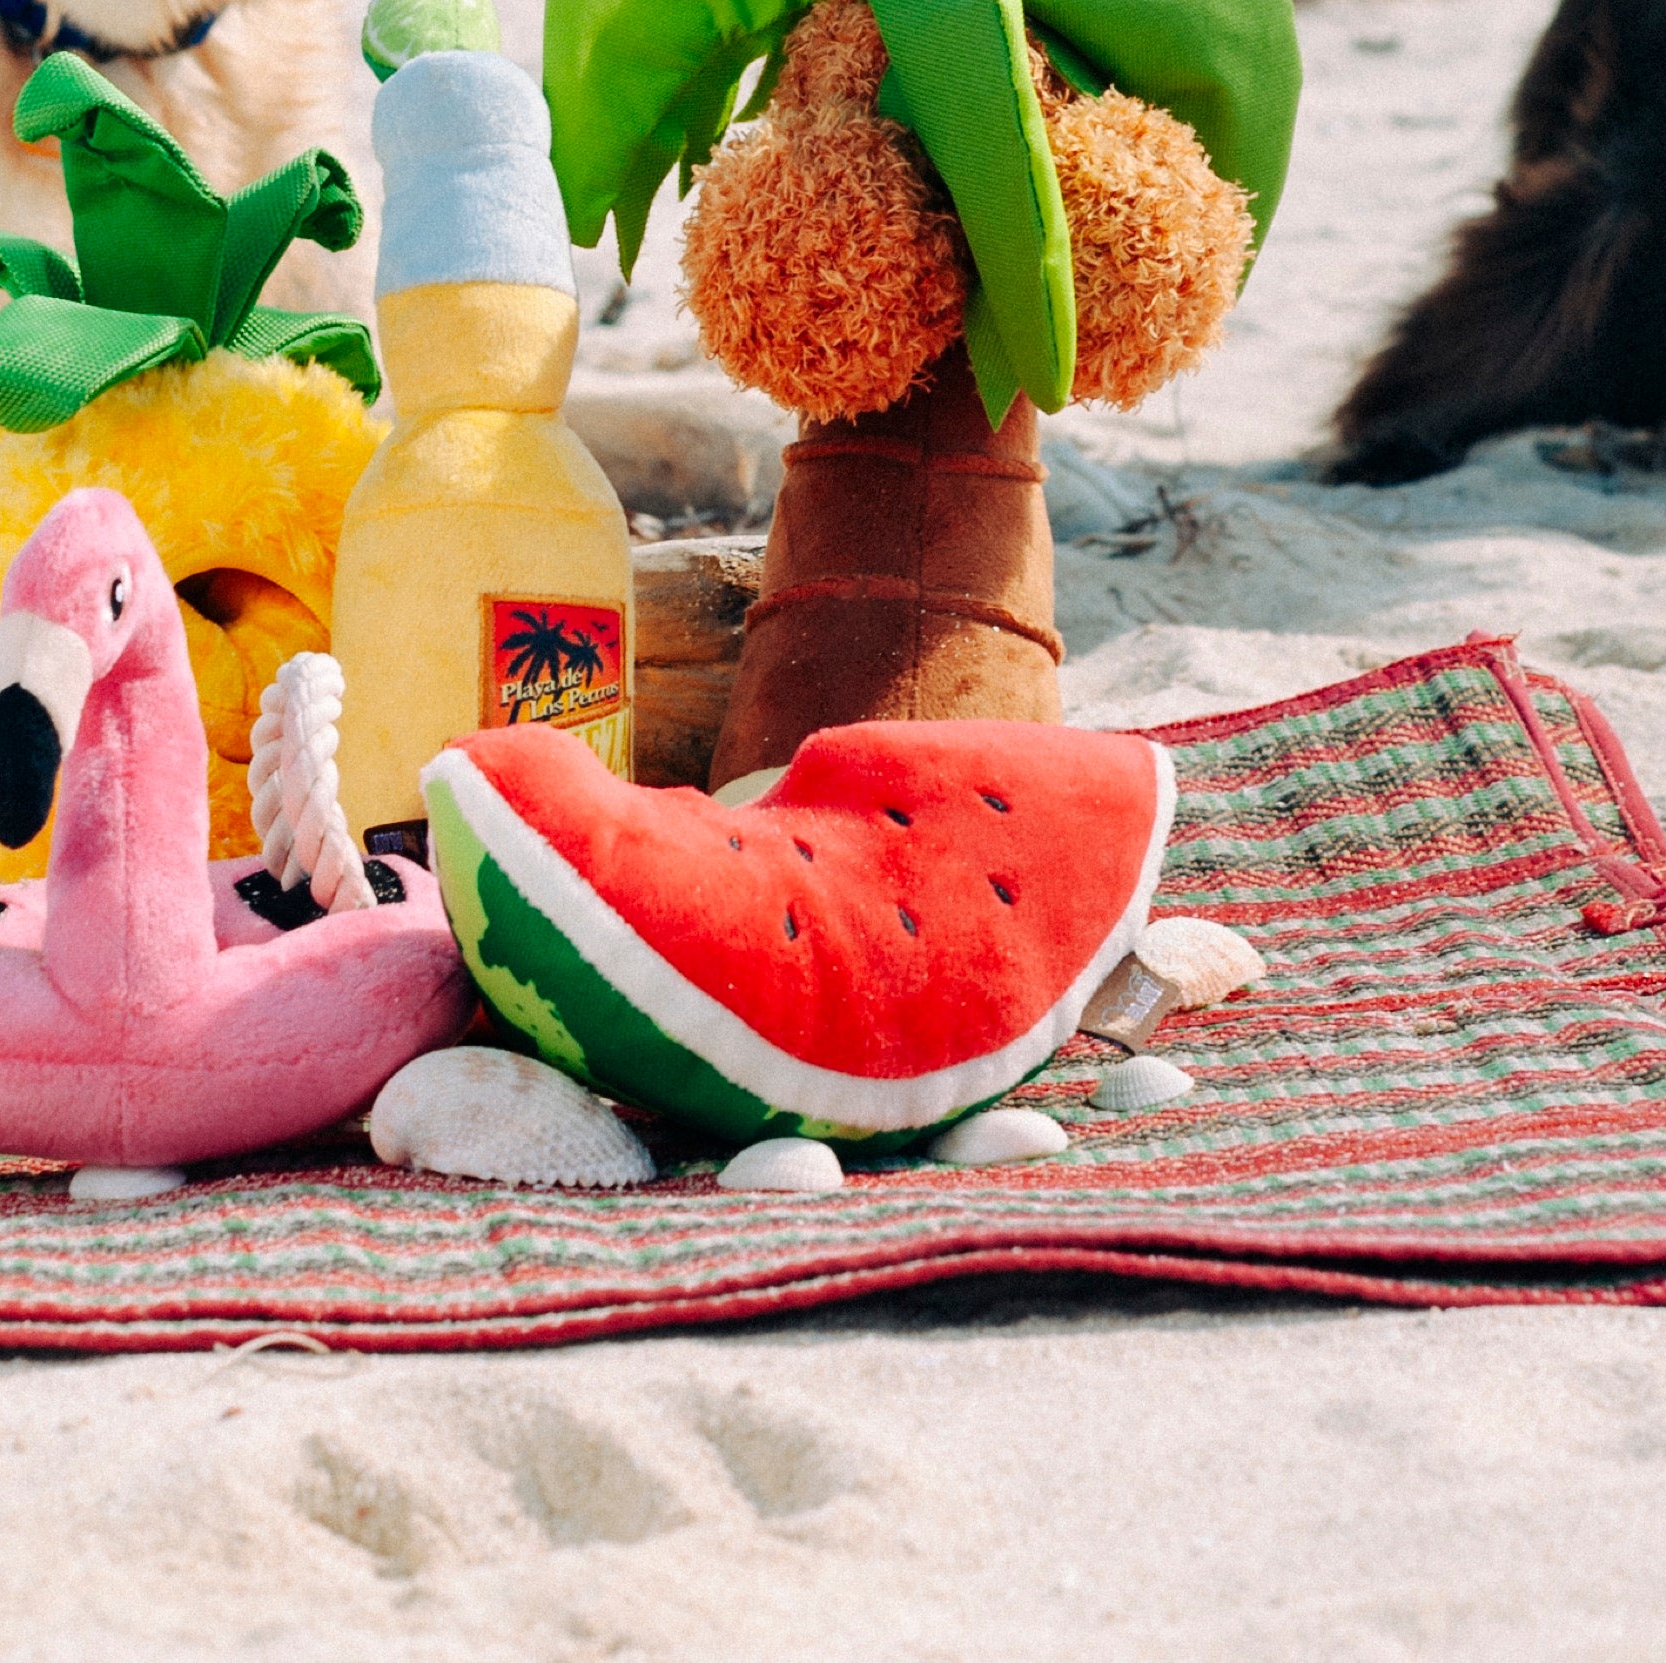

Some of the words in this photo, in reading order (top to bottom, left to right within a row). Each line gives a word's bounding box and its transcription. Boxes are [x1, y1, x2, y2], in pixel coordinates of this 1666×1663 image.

[501, 680, 556, 705] Playa
[562, 667, 582, 688] de
[530, 700, 564, 720] Los
